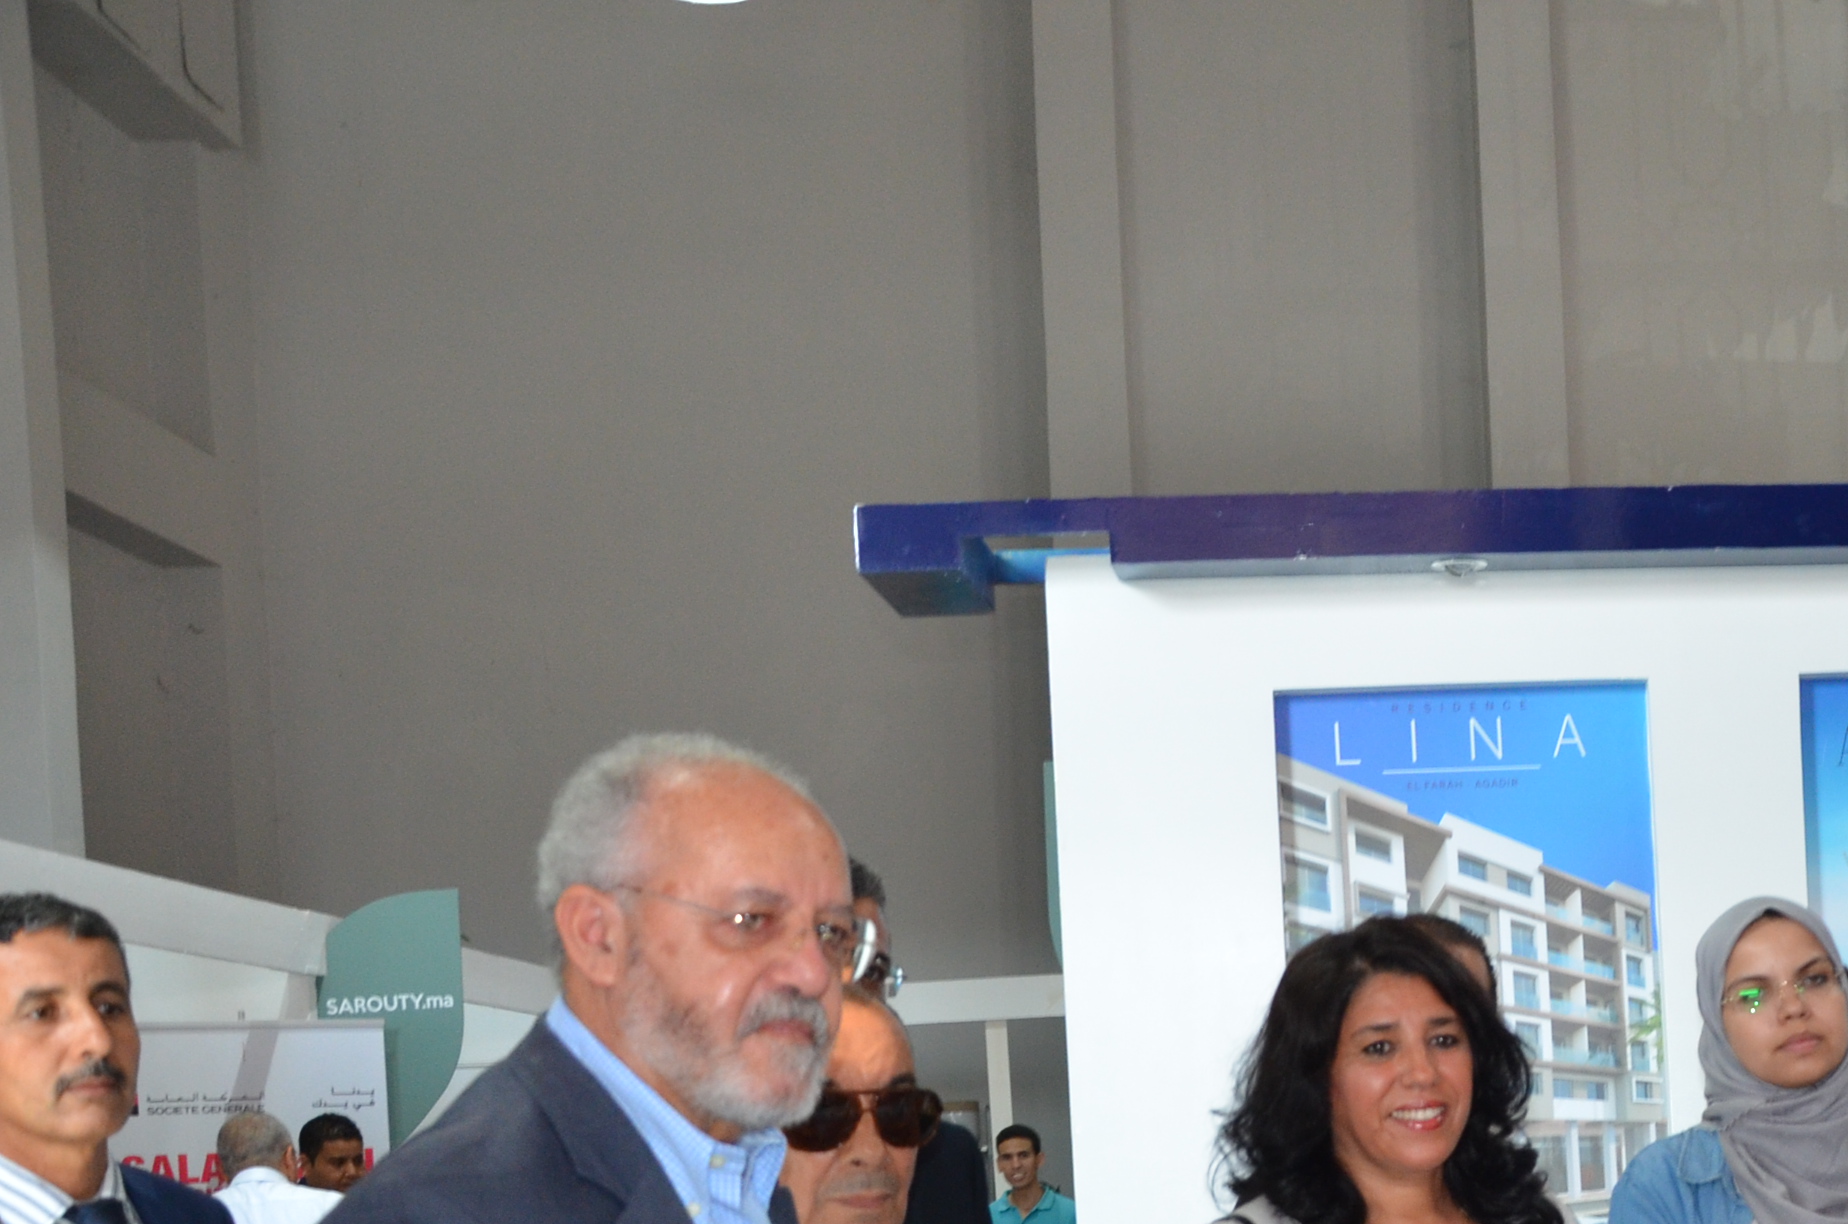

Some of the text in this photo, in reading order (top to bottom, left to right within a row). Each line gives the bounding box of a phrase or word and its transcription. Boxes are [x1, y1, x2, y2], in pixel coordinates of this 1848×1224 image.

[1391, 700, 1528, 715] RESIDENCE
[1333, 712, 1587, 767] LINA
[326, 992, 454, 1016] SAROUTY.ma
